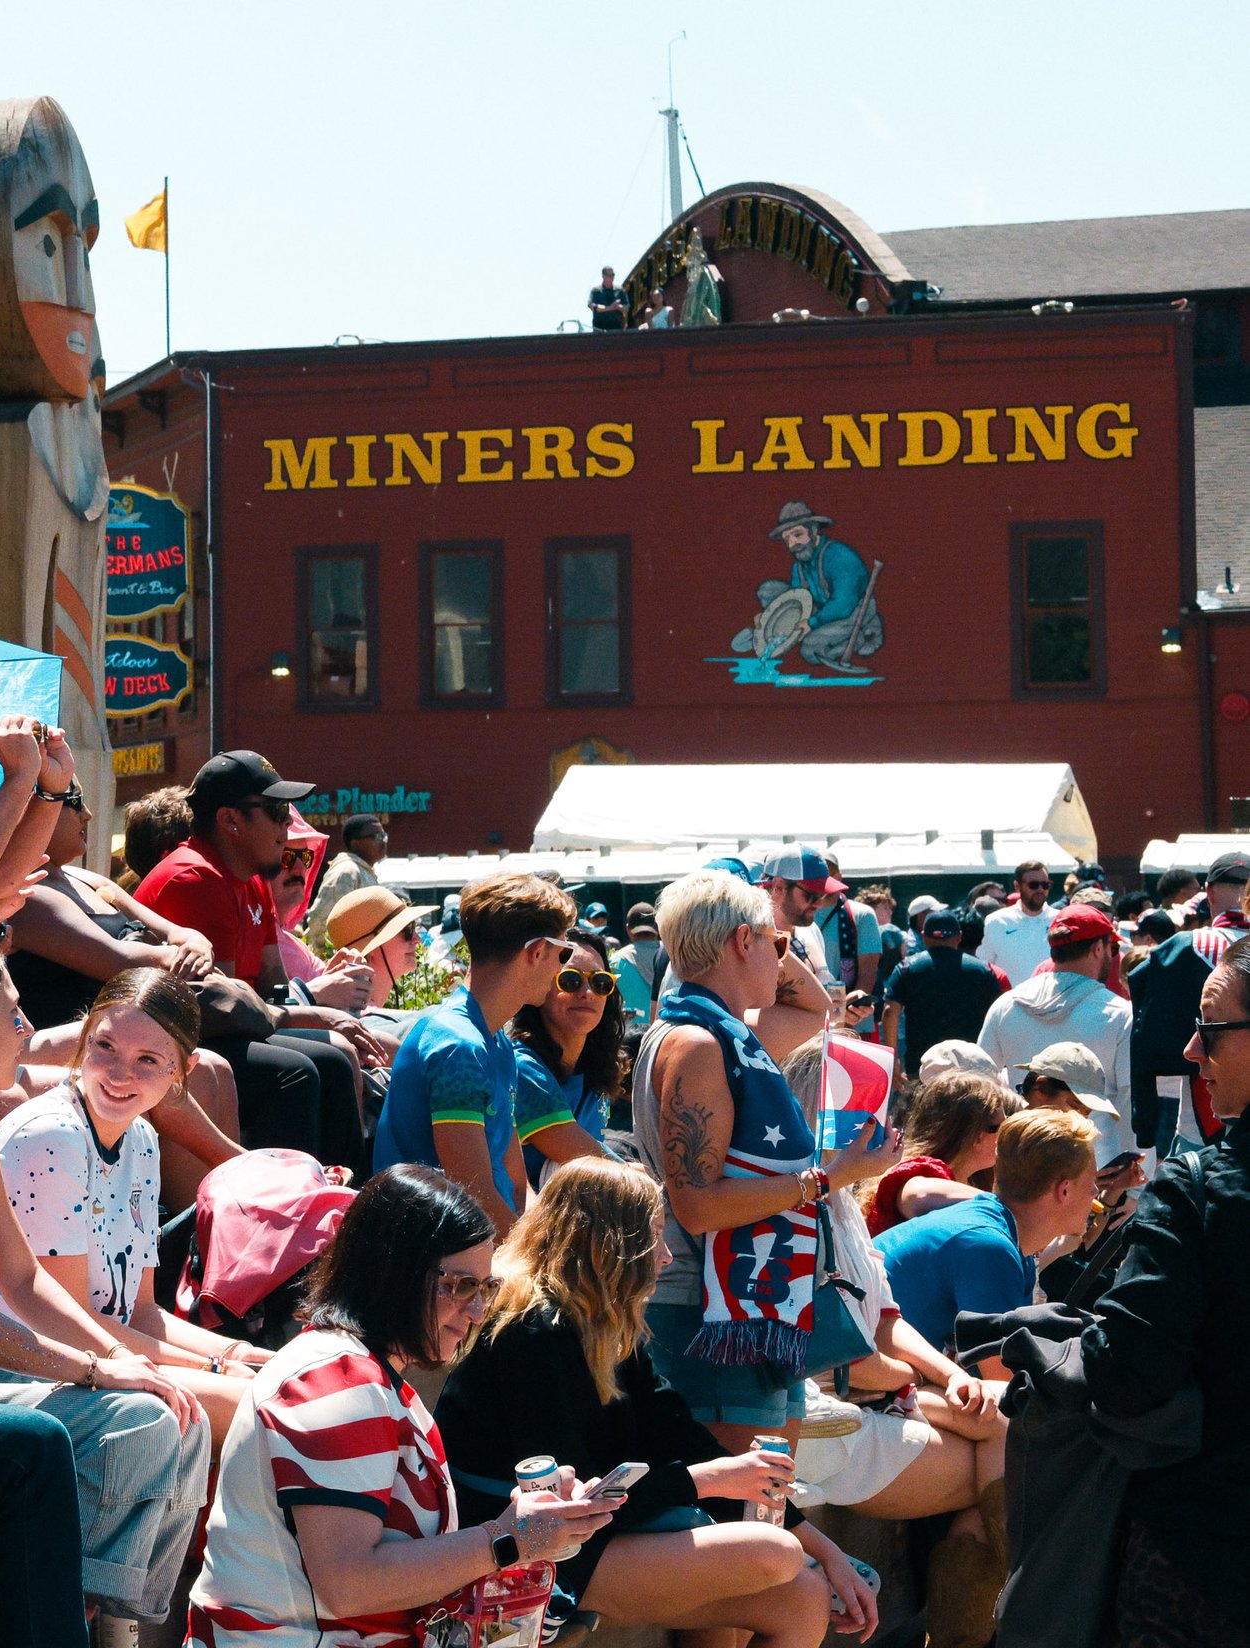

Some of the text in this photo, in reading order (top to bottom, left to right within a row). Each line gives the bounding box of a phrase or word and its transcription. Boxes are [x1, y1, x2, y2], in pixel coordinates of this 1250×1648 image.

[263, 402, 1139, 490] MINERS LANDING
[123, 672, 171, 696] DECK
[336, 784, 430, 813] Plunder
